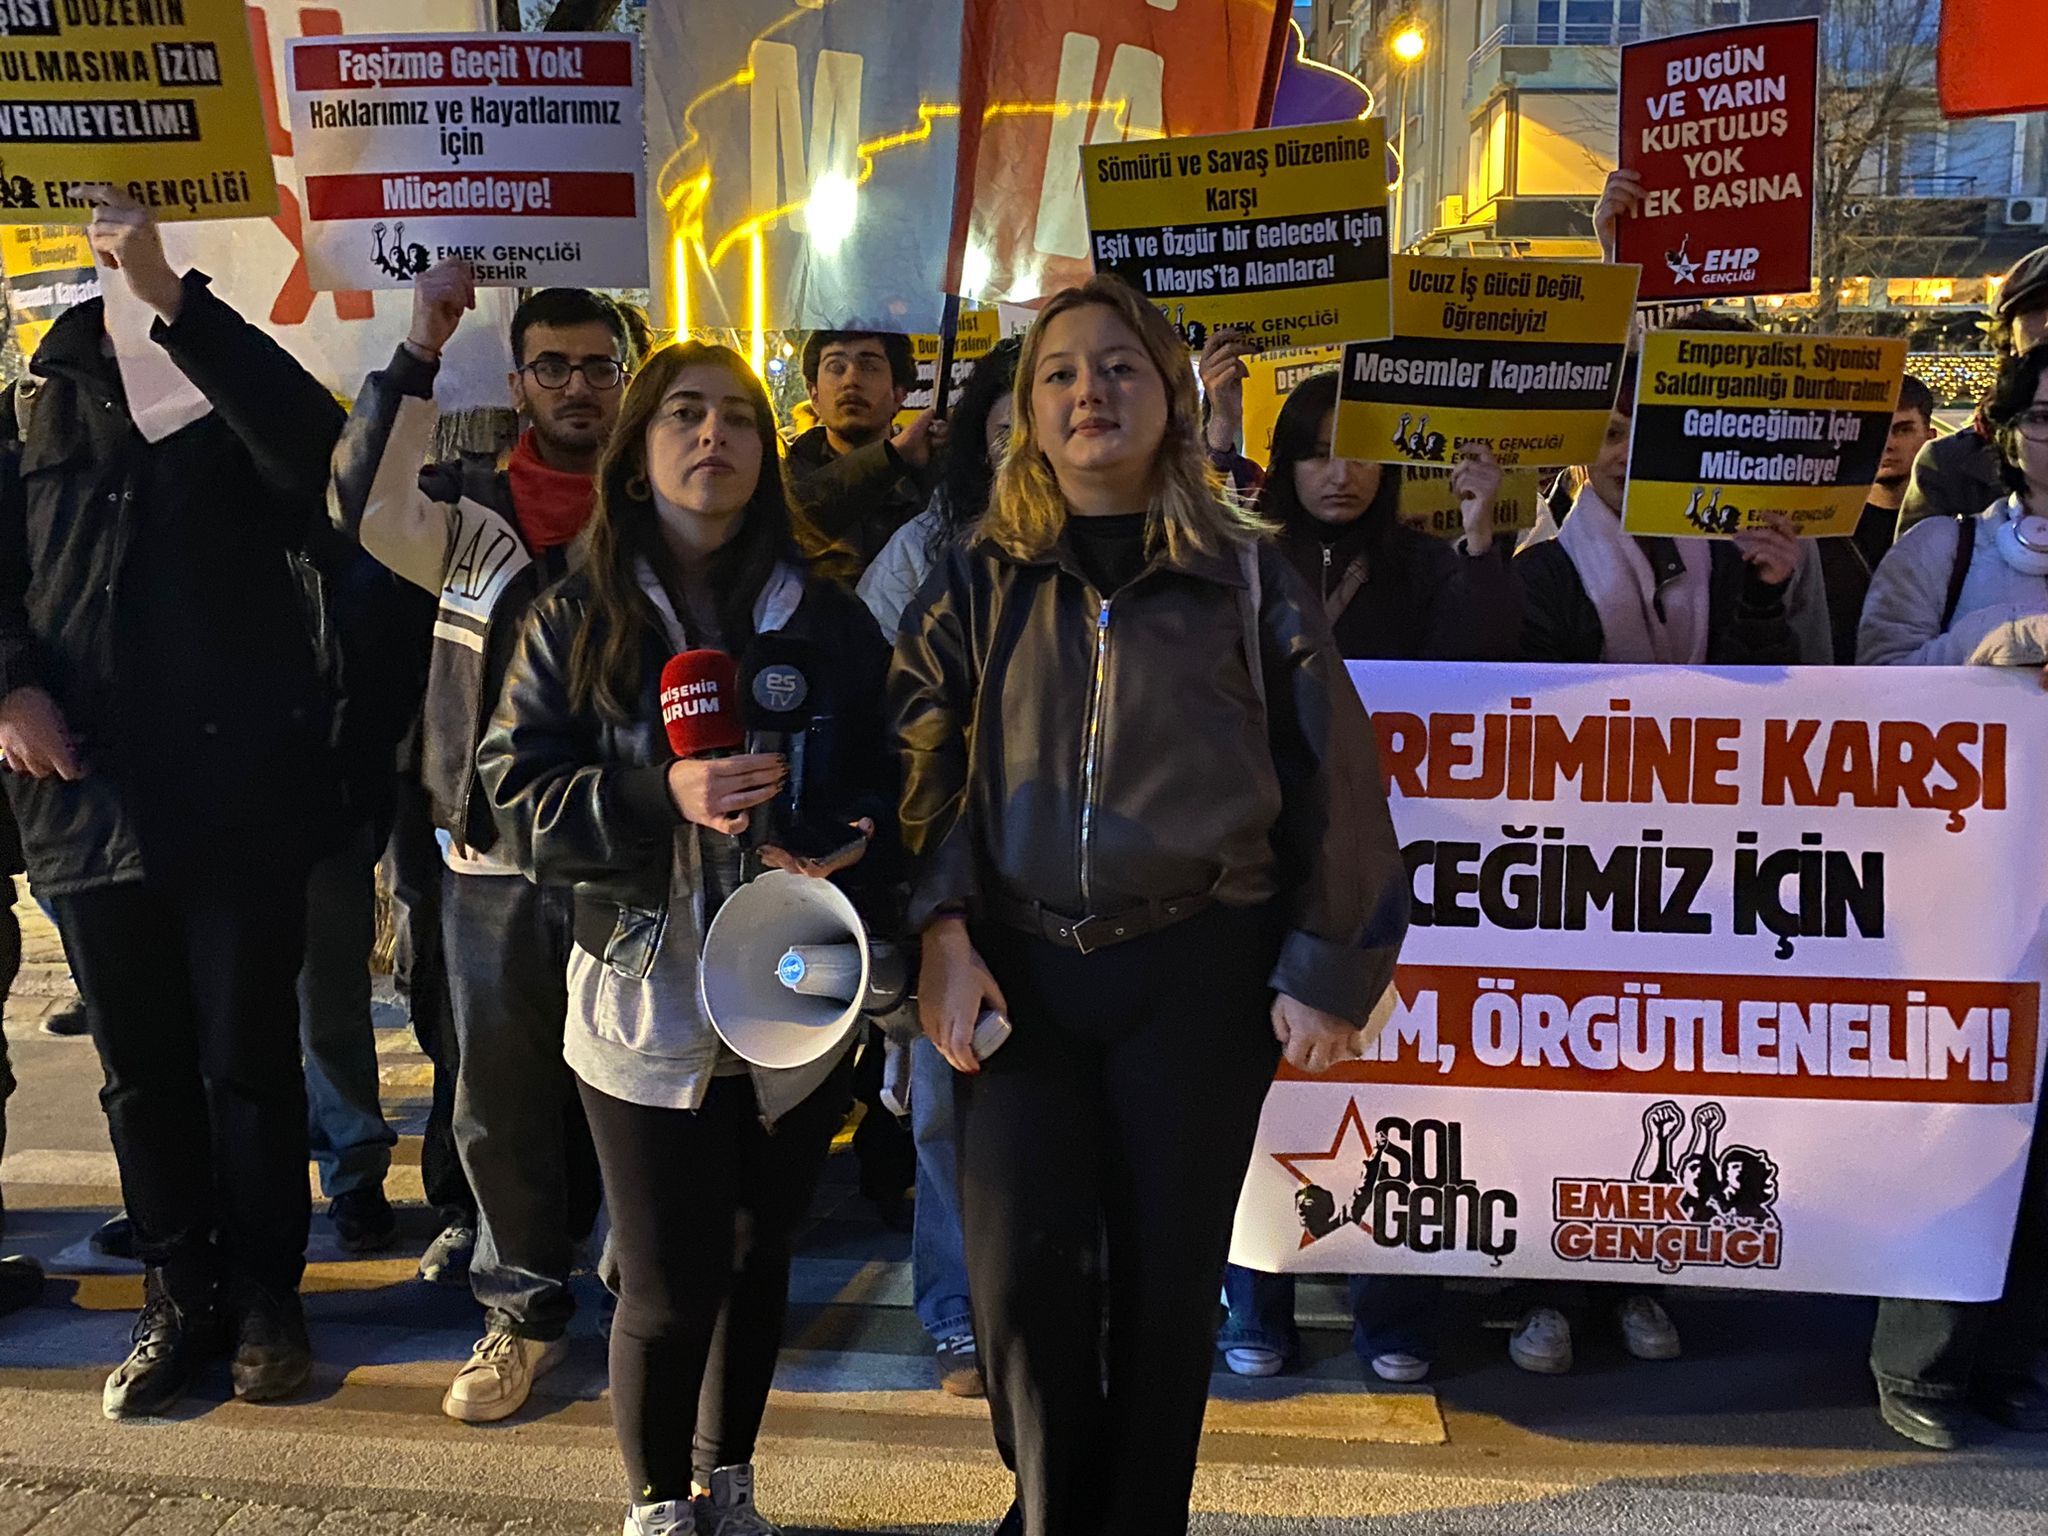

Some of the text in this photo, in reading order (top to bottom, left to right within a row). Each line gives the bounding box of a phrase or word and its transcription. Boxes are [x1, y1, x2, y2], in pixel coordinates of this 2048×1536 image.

[0, 43, 219, 82] ULMASINA İZİN
[337, 45, 583, 88] Faşizme Geçit Yok!
[1666, 44, 1766, 87] BUGÜN
[0, 98, 192, 136] VERMEYELİM!
[310, 96, 621, 129] Haklarımız ve Hayatlarımız
[1646, 75, 1787, 121] VE YARIN
[440, 126, 484, 164] için
[1641, 108, 1789, 153] KURTULUŞ
[1097, 135, 1370, 183] Sömürü ve Savaş Düzenine
[1682, 146, 1745, 180] YOK
[127, 171, 250, 213] GENÇLİĞİ
[382, 176, 552, 212] Mücadeleye!
[1206, 187, 1259, 217] Karşı
[1694, 172, 1803, 213] BAŞINA
[436, 242, 581, 265] EMEK GENÇLİĞİ
[1096, 212, 1383, 266] Eşit ve Özgür bir Gelecek için
[470, 261, 527, 282] İŞEHİR
[1142, 271, 1152, 293] 1
[1245, 254, 1336, 286] Alanlara!
[1701, 269, 1756, 285] GENÇLİĞİ
[1703, 247, 1760, 272] EHP
[1409, 267, 1585, 301] Ucuz İş Gücü Değil,
[1261, 309, 1339, 332] GENÇLİĞİ
[1442, 302, 1548, 334] Öğrenciyiz!
[1353, 352, 1485, 388] Mesemler
[1489, 359, 1613, 394] Kapatılsın!
[1677, 339, 1881, 371] Emperyalist, Siyonist
[1654, 370, 1891, 403] Saldırganlığı Durduralım!
[1683, 408, 1824, 442] Geleceğimiz
[1700, 451, 1841, 486] Mücadeleye!
[662, 697, 720, 726] URUM
[768, 690, 793, 706] TV
[1371, 697, 2007, 832] REJİMİNE KARŞI
[1732, 830, 1886, 960] İÇİN
[1471, 977, 2011, 1082] ÖRGÜTLENELİM!
[1558, 1181, 1687, 1222] EMEK
[1372, 1180, 1518, 1267] Genç
[1556, 1216, 1779, 1273] GENÇLİĞİ
